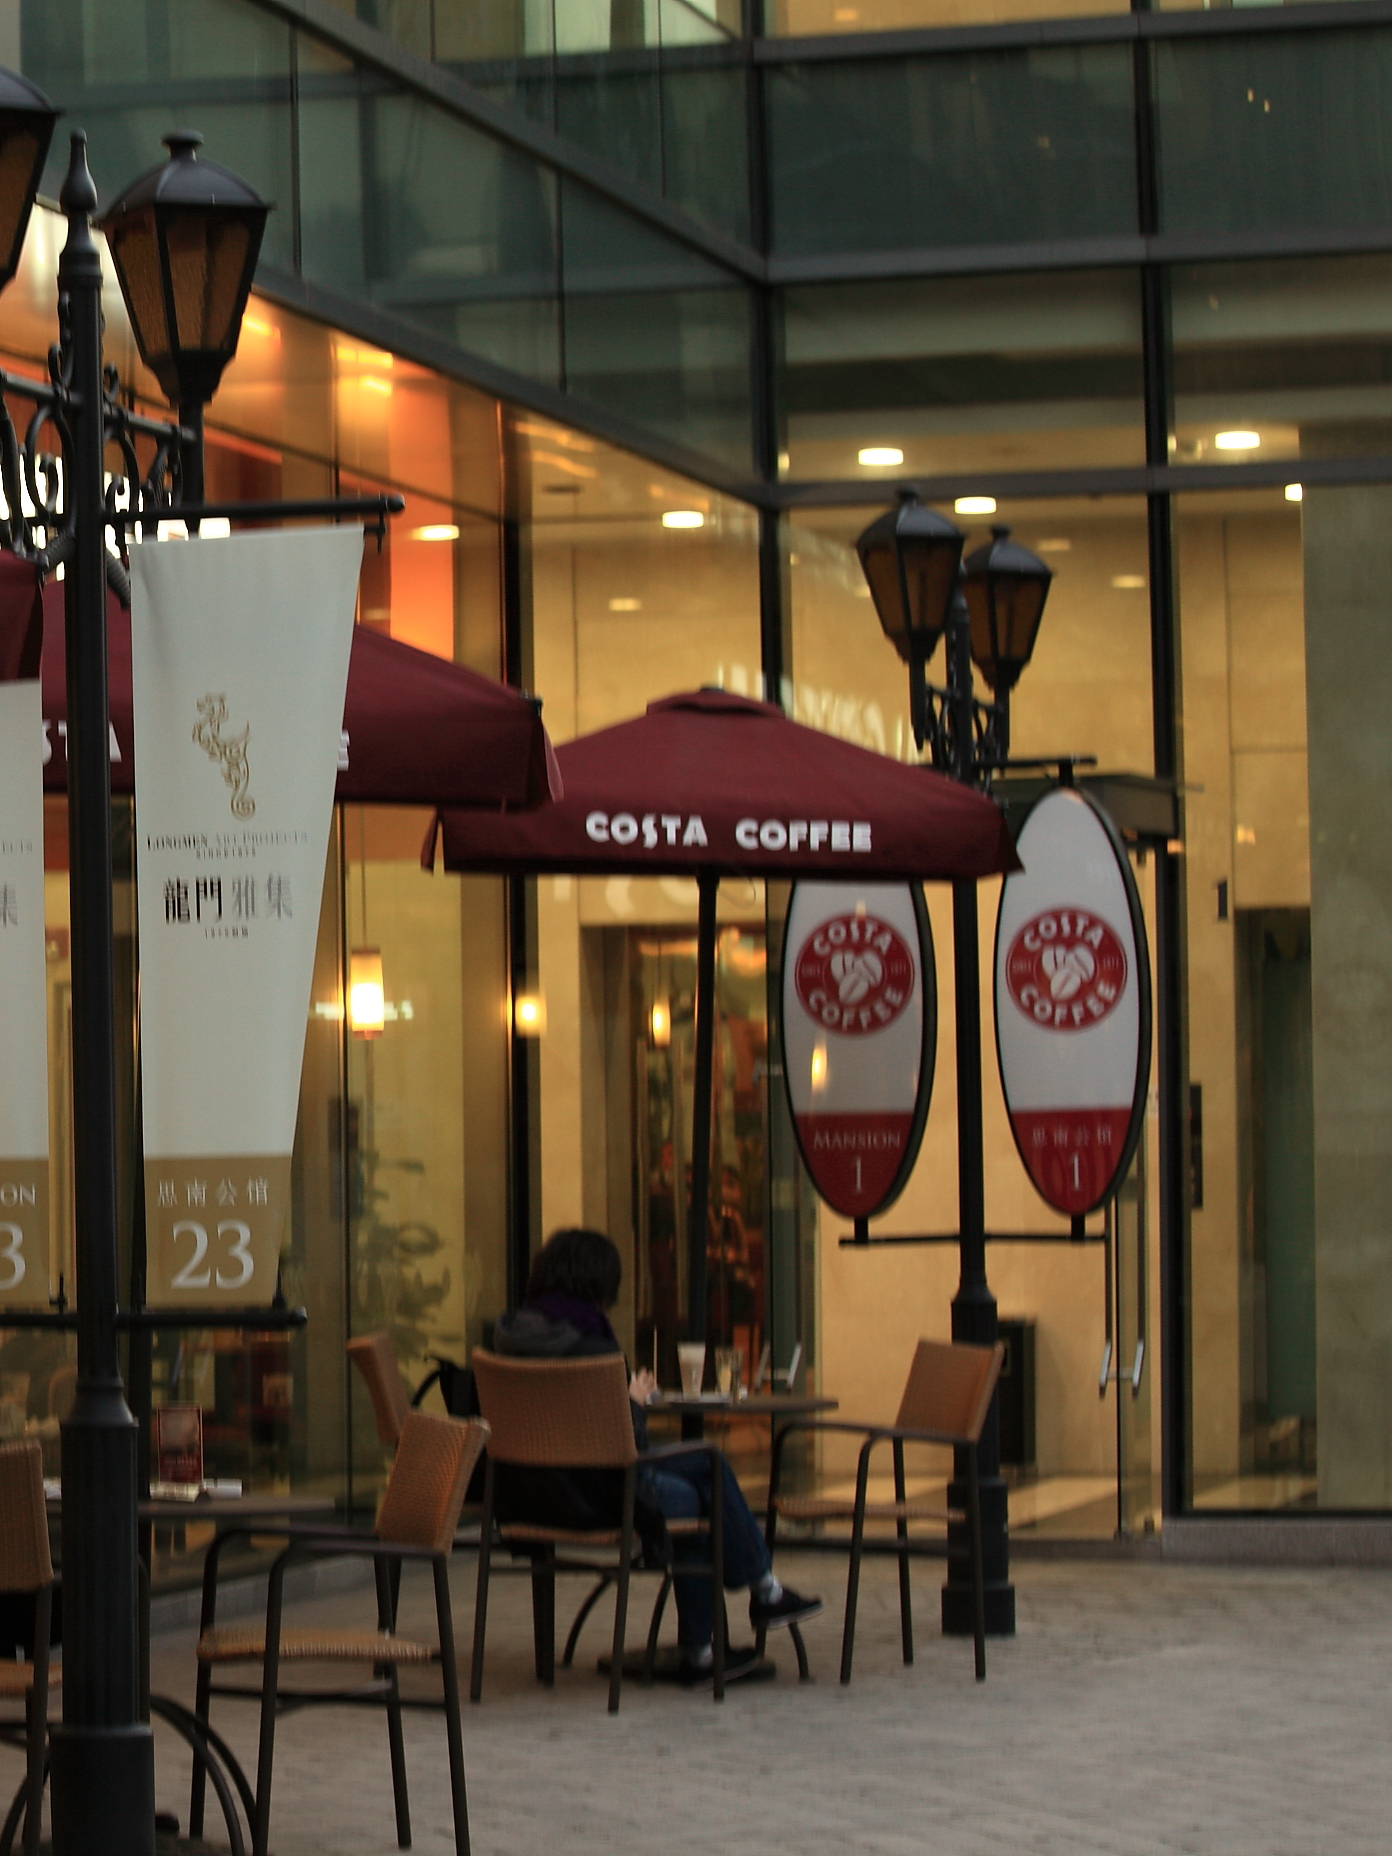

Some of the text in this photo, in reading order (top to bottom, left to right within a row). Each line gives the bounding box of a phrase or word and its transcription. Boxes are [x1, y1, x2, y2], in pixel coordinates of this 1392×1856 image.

[585, 811, 872, 852] COSTA COFFEE
[813, 917, 892, 956] COSTA
[1023, 912, 1104, 951] COSTA
[809, 986, 903, 1031] COFFEE
[1020, 979, 1116, 1026] COFFEE
[813, 1130, 901, 1149] MANSION
[854, 1154, 862, 1194] 1
[1072, 1153, 1080, 1191] 1
[171, 1220, 254, 1289] 23
